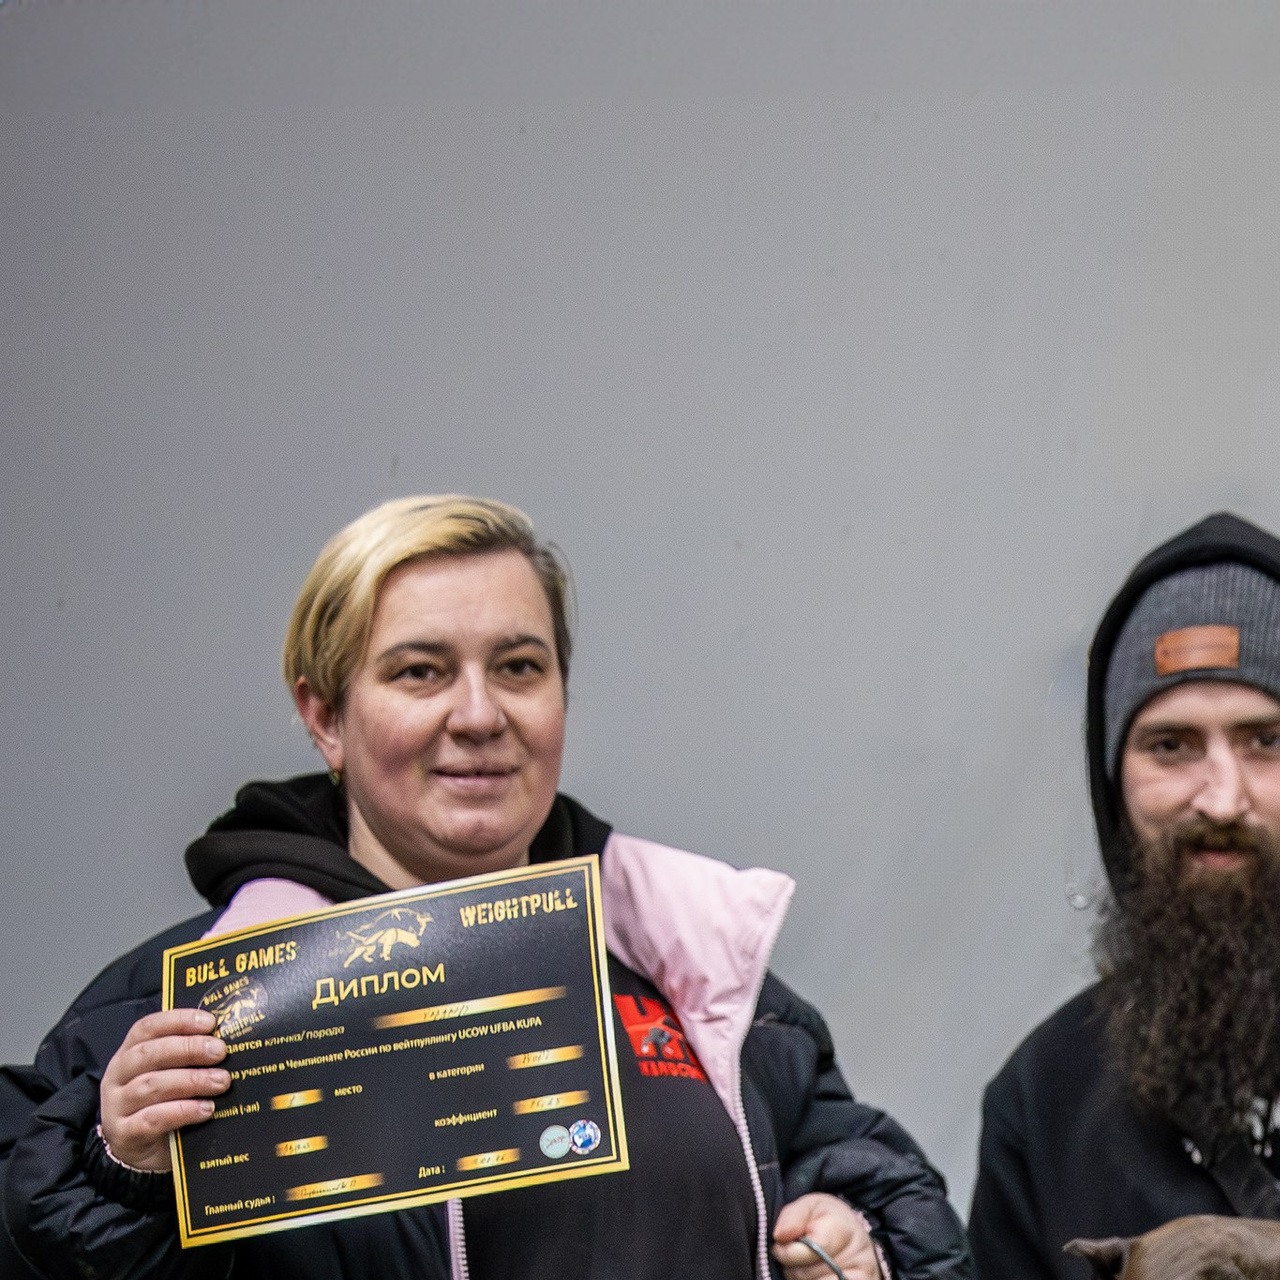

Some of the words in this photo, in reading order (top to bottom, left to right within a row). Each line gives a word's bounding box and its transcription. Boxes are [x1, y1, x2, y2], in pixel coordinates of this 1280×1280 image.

[460, 888, 578, 928] WEIGHTPULL
[186, 958, 229, 987] BULL
[235, 940, 299, 973] GAMES
[242, 1063, 278, 1080] участие
[279, 1063, 286, 1072] в
[286, 1053, 343, 1070] Чемпионате
[344, 1045, 378, 1060] России
[379, 1044, 392, 1054] по
[458, 1025, 489, 1040] UCOW
[516, 1016, 543, 1031] KUPA
[436, 1063, 485, 1080] категории
[334, 1084, 363, 1097] место
[434, 1108, 498, 1127] коэффициент
[200, 1154, 233, 1170] взятый
[233, 1152, 250, 1164] вес
[205, 1200, 244, 1216] Главный
